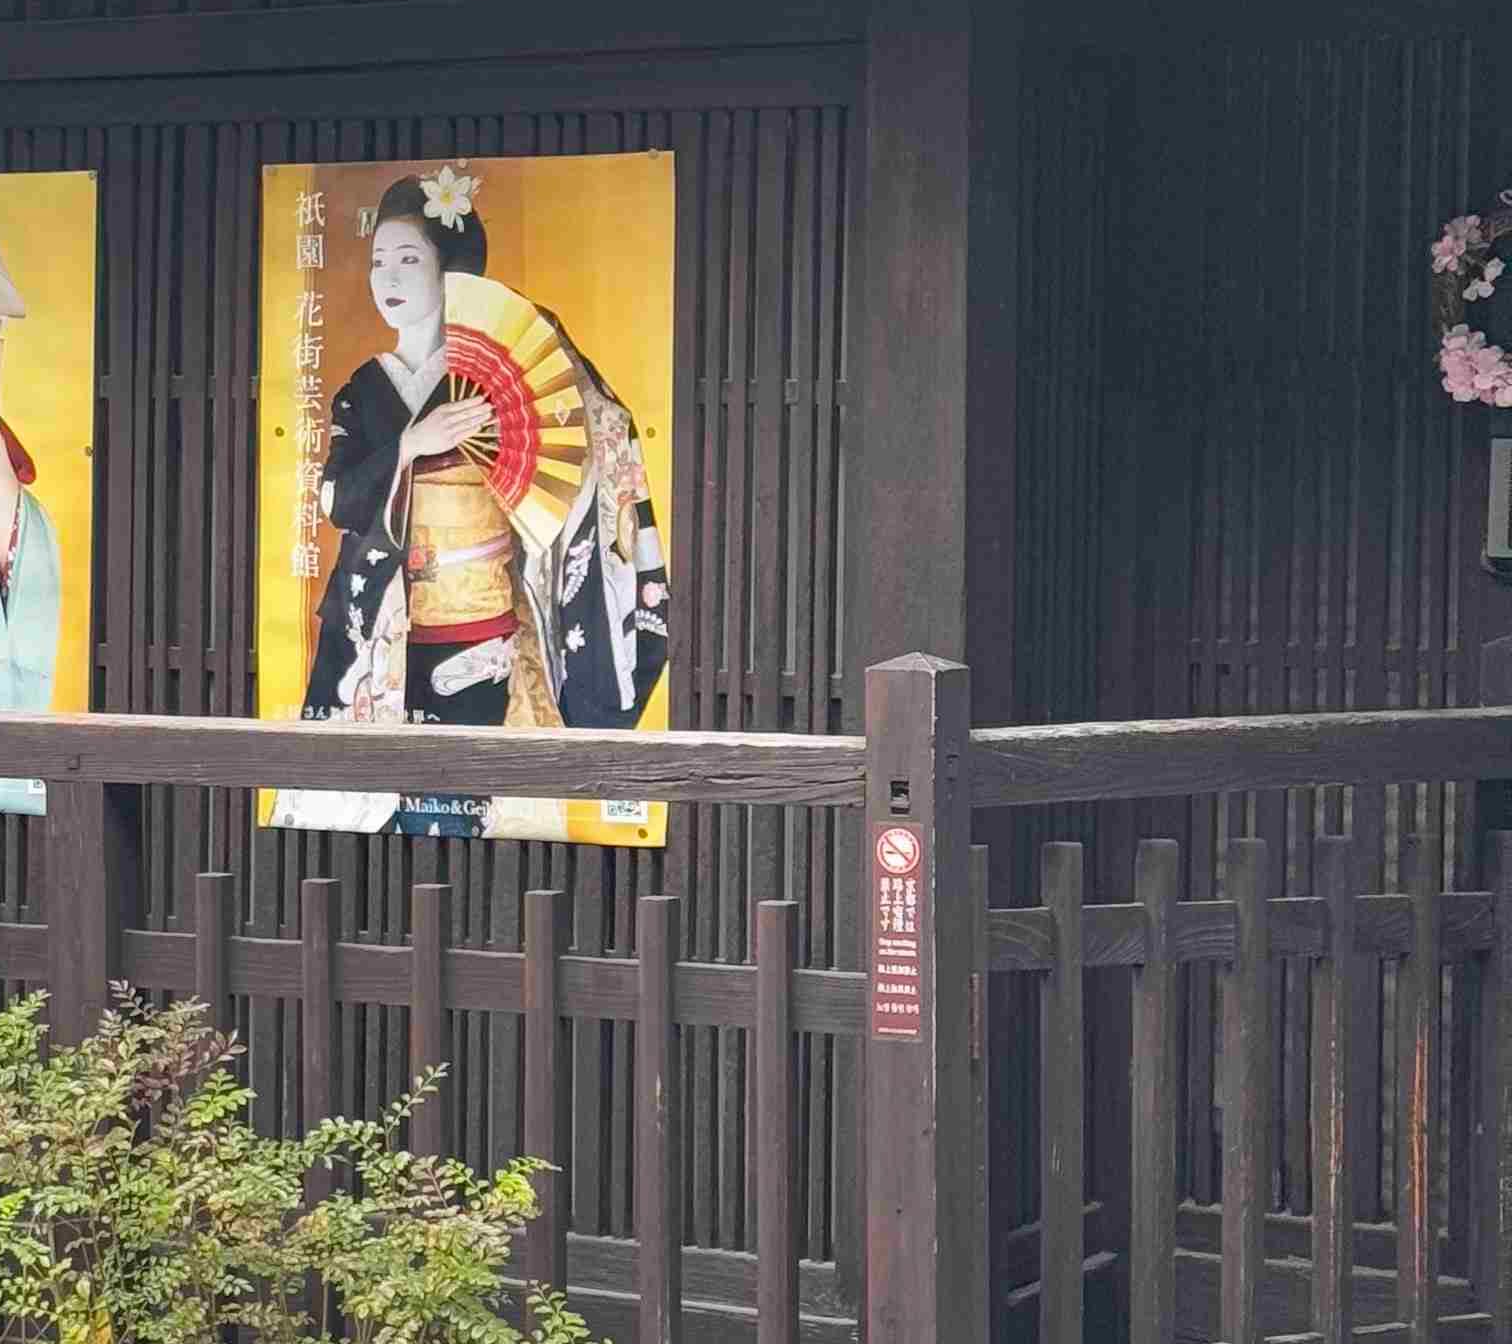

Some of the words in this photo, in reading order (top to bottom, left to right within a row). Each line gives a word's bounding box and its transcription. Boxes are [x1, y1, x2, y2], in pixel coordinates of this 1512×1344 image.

[296, 191, 326, 271] 祇園
[291, 291, 327, 578] 花街芸術資料館
